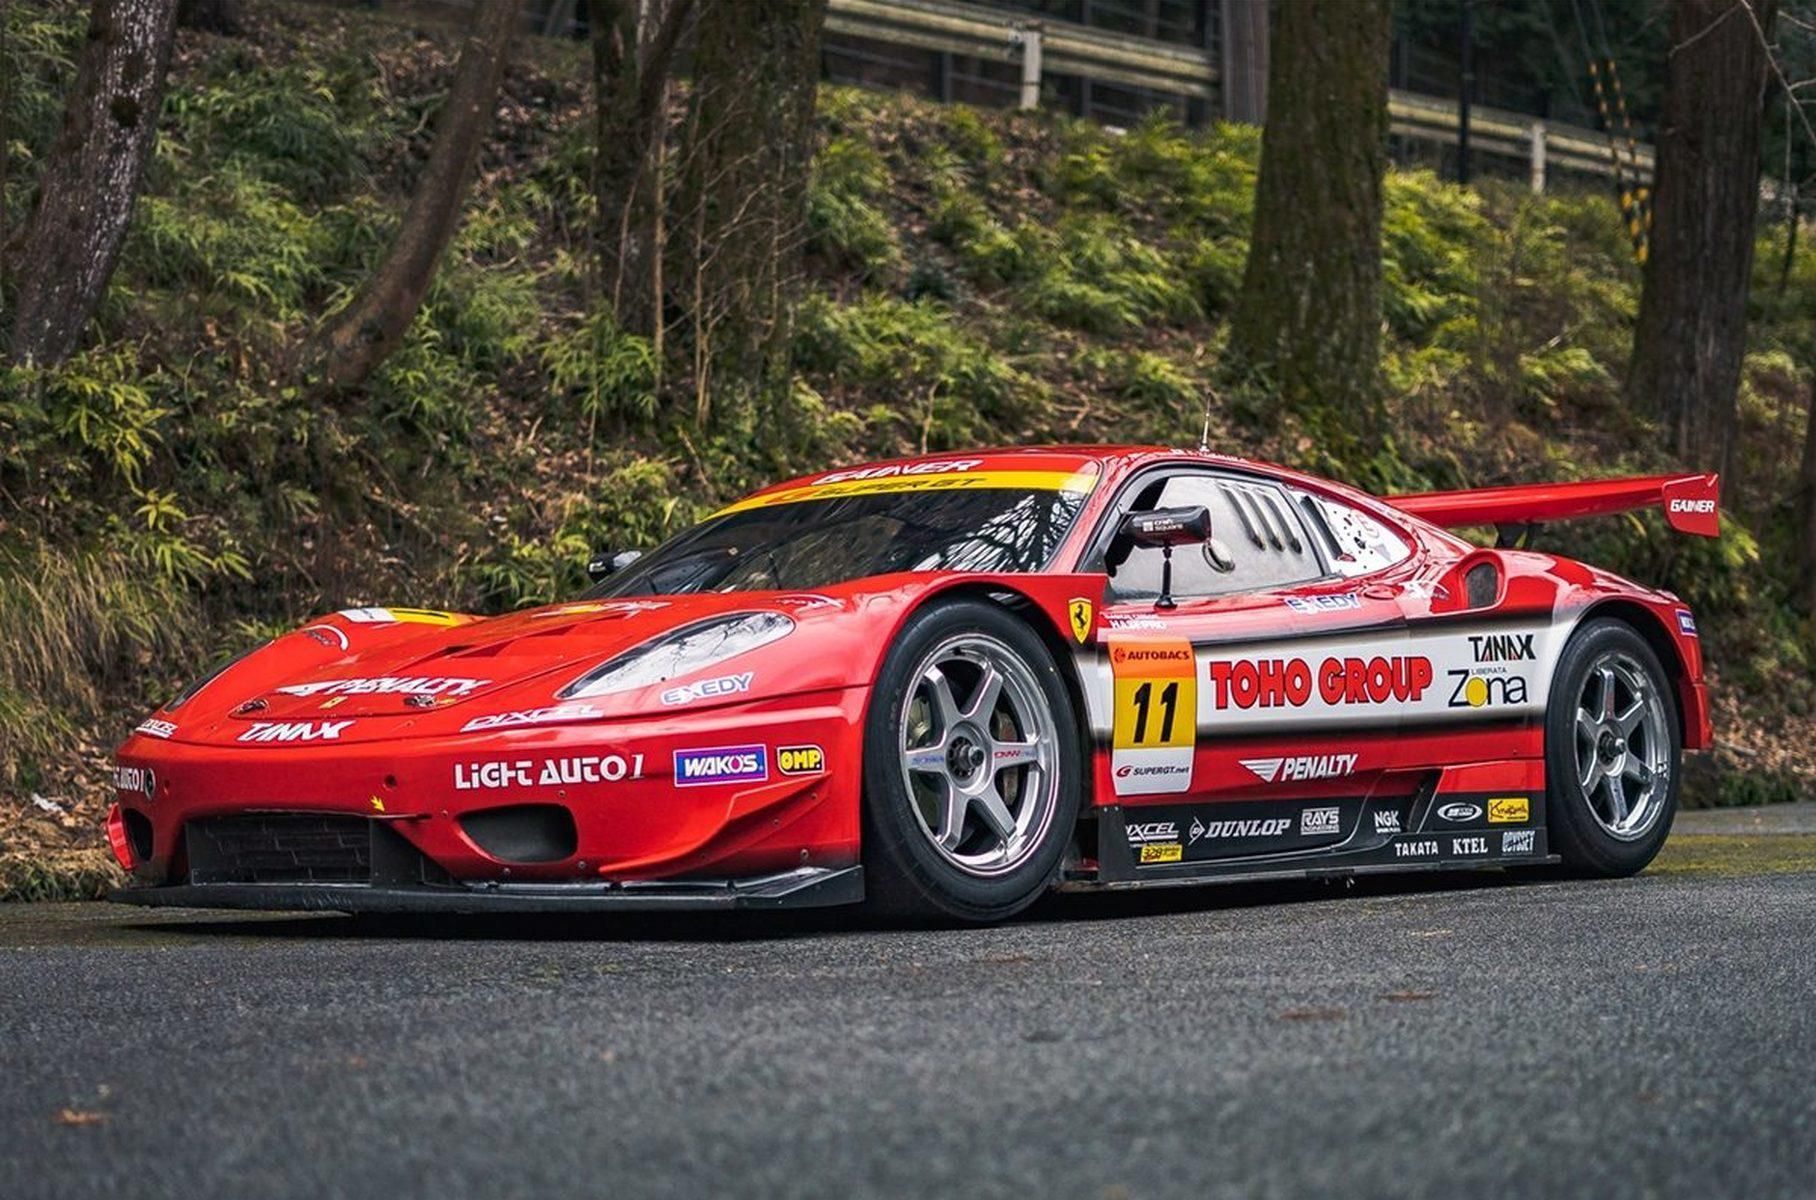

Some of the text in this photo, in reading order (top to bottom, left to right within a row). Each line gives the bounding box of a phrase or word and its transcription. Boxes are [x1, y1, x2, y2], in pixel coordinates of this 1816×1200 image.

[1127, 650, 1190, 661] AUTOBACS
[1468, 634, 1536, 662] TANAX
[661, 672, 753, 705] EXEDY
[1210, 656, 1433, 710] TOHO GROUP
[1448, 669, 1528, 707] Zona
[1133, 682, 1179, 744] 11
[1281, 754, 1358, 781] PENALTY
[1205, 819, 1291, 838] DUNLOP
[1302, 811, 1339, 826] RAYS
[1374, 810, 1400, 827] NGK
[1395, 841, 1439, 856] TAKATA
[1452, 837, 1488, 855] KTEL
